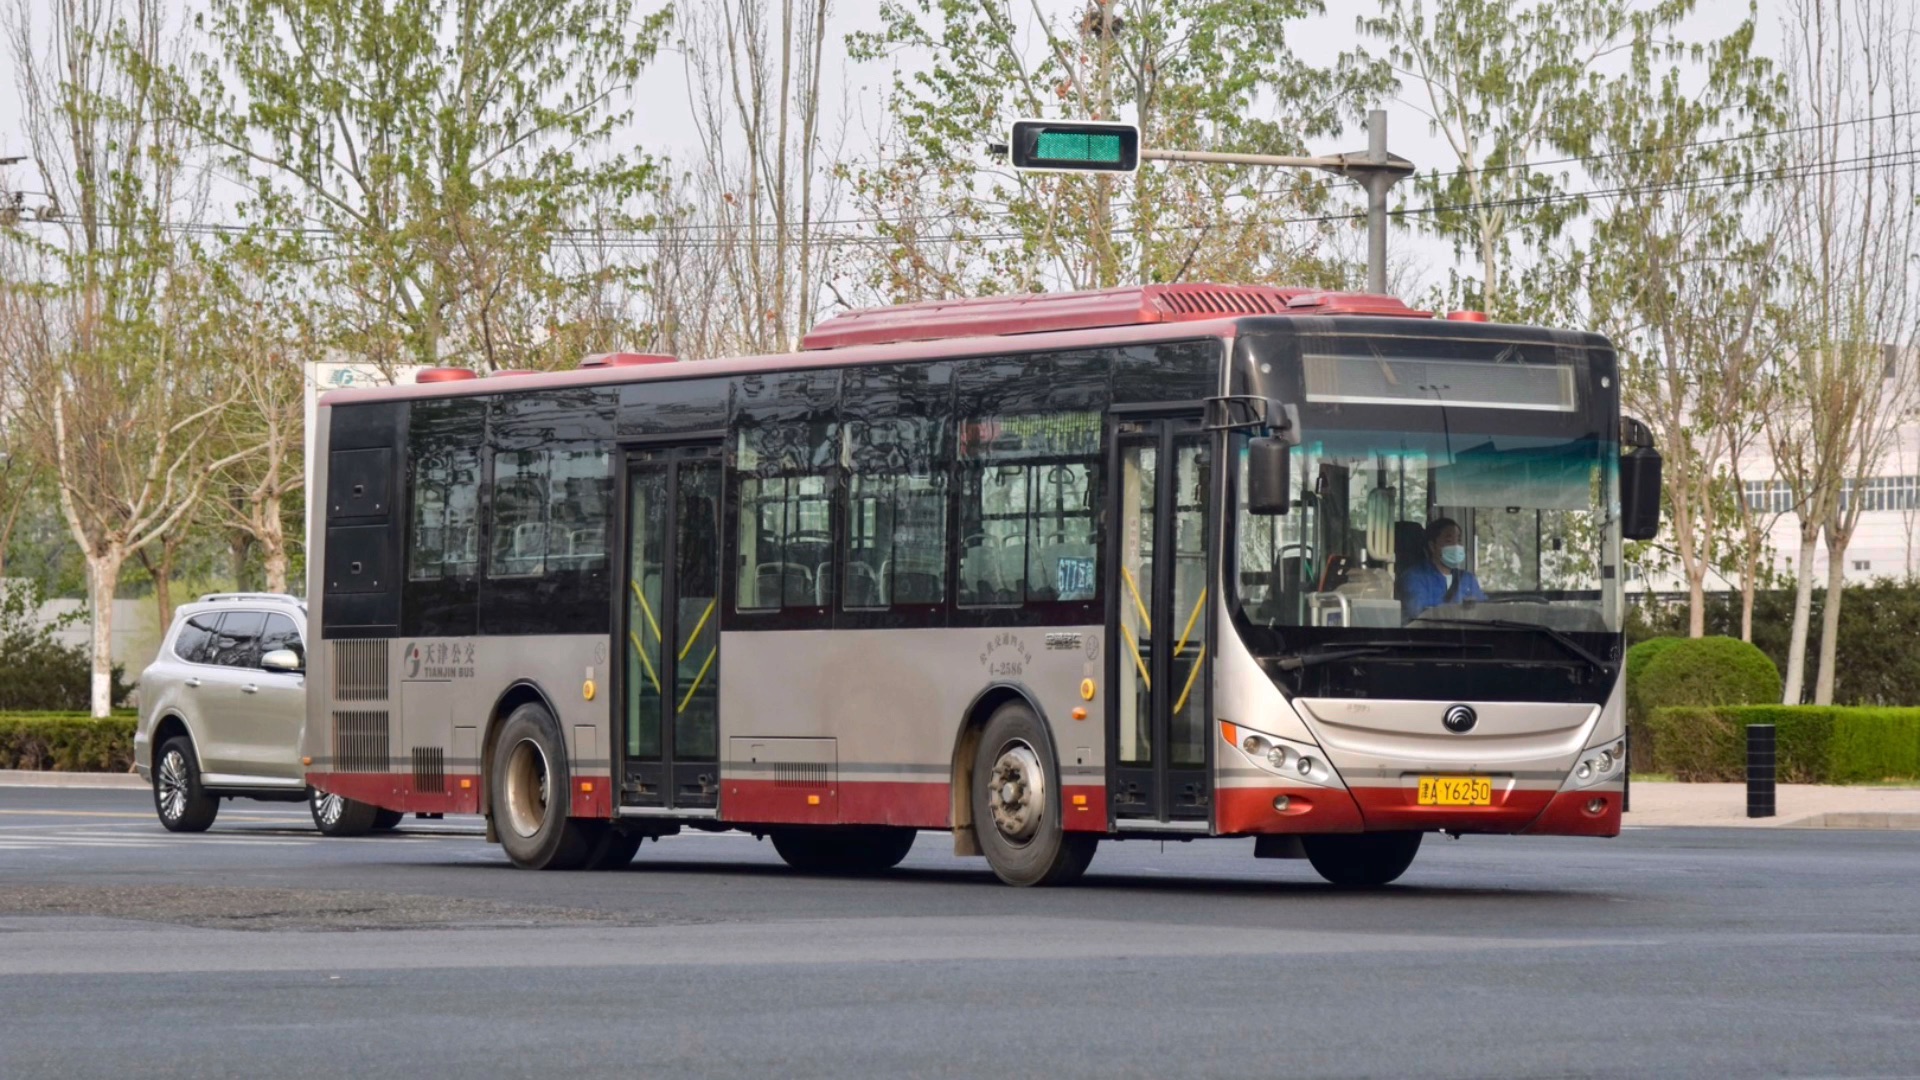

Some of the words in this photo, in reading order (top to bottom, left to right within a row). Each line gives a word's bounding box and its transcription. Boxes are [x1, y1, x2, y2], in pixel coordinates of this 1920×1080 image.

[424, 643, 475, 665] 天津公交
[424, 667, 456, 678] TIANJIN
[458, 667, 475, 678] BUS
[988, 662, 1022, 676] 4-2586
